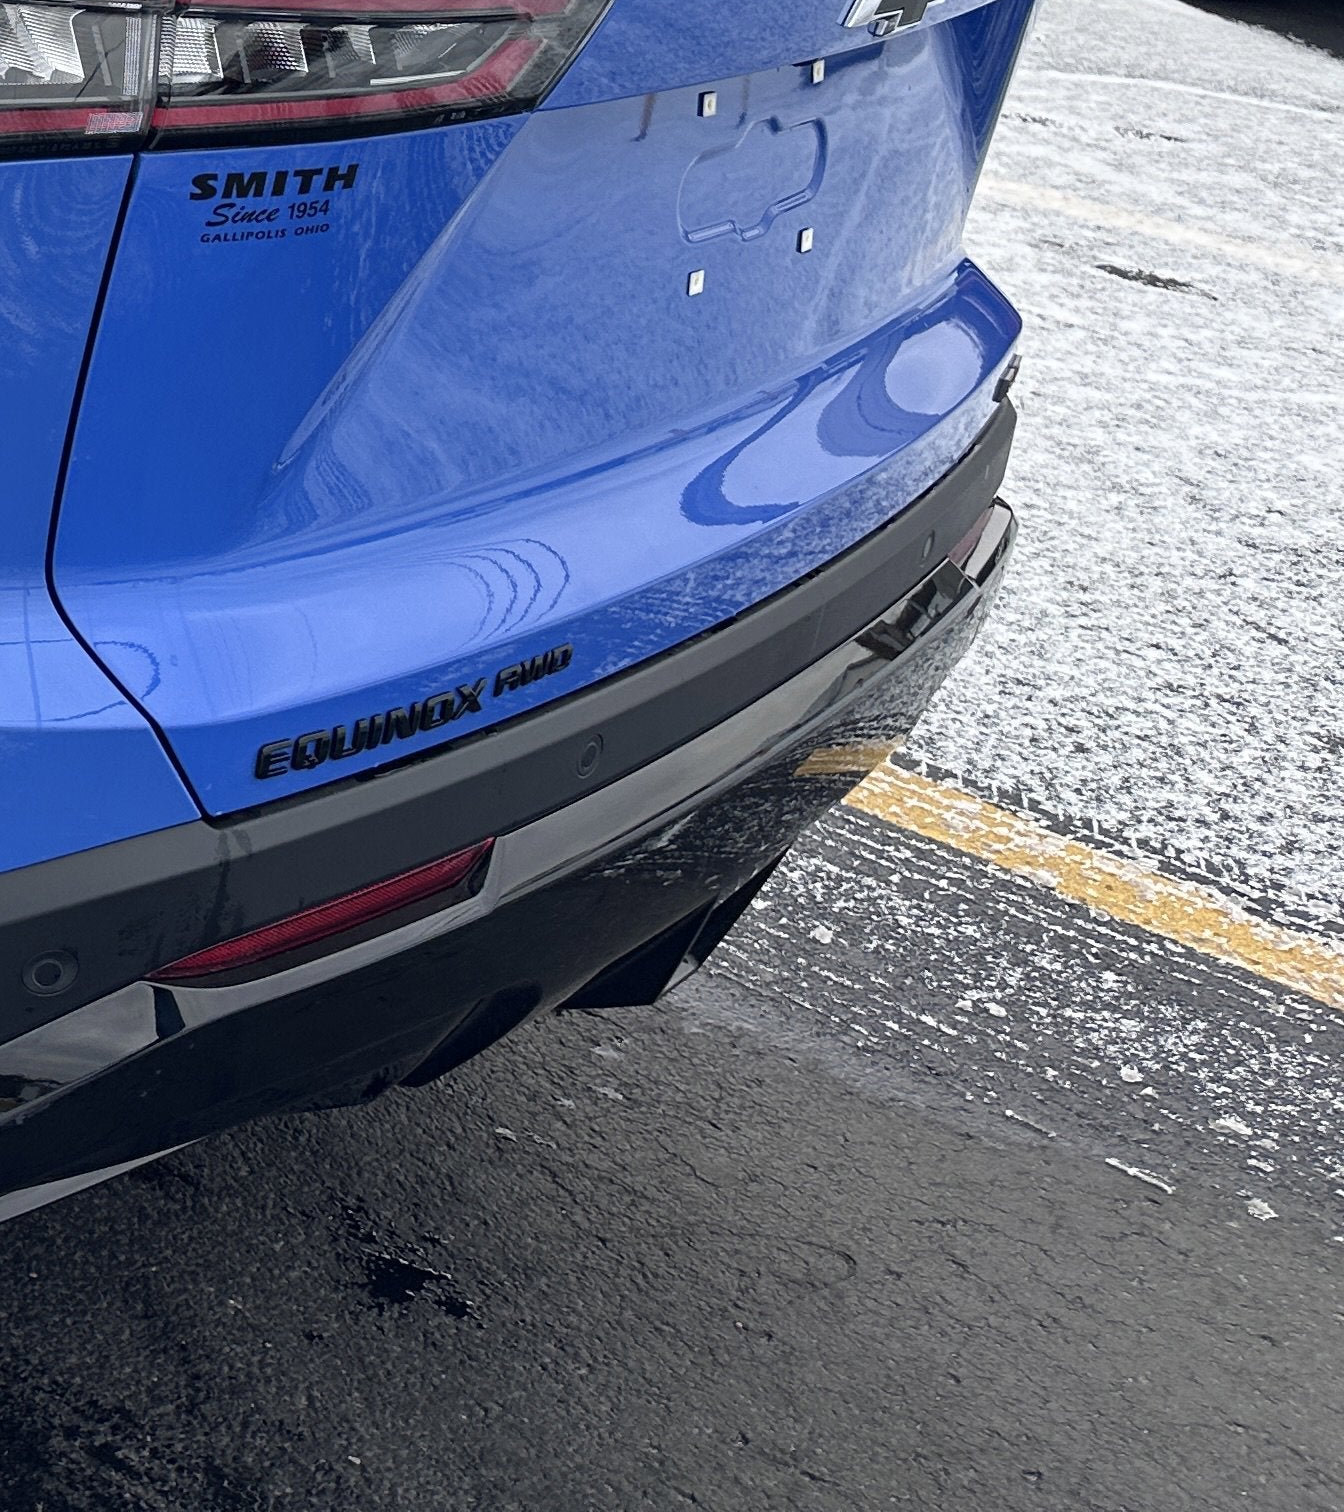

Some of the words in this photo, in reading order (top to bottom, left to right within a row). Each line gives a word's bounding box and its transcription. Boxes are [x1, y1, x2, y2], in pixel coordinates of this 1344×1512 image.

[189, 163, 359, 201] SMITH
[205, 202, 280, 227] Since
[287, 199, 330, 220] 1954
[199, 228, 287, 243] GALLIPOLIS
[293, 223, 330, 236] OHIO
[254, 677, 488, 780] EQUINOX
[492, 642, 574, 698] AWD
